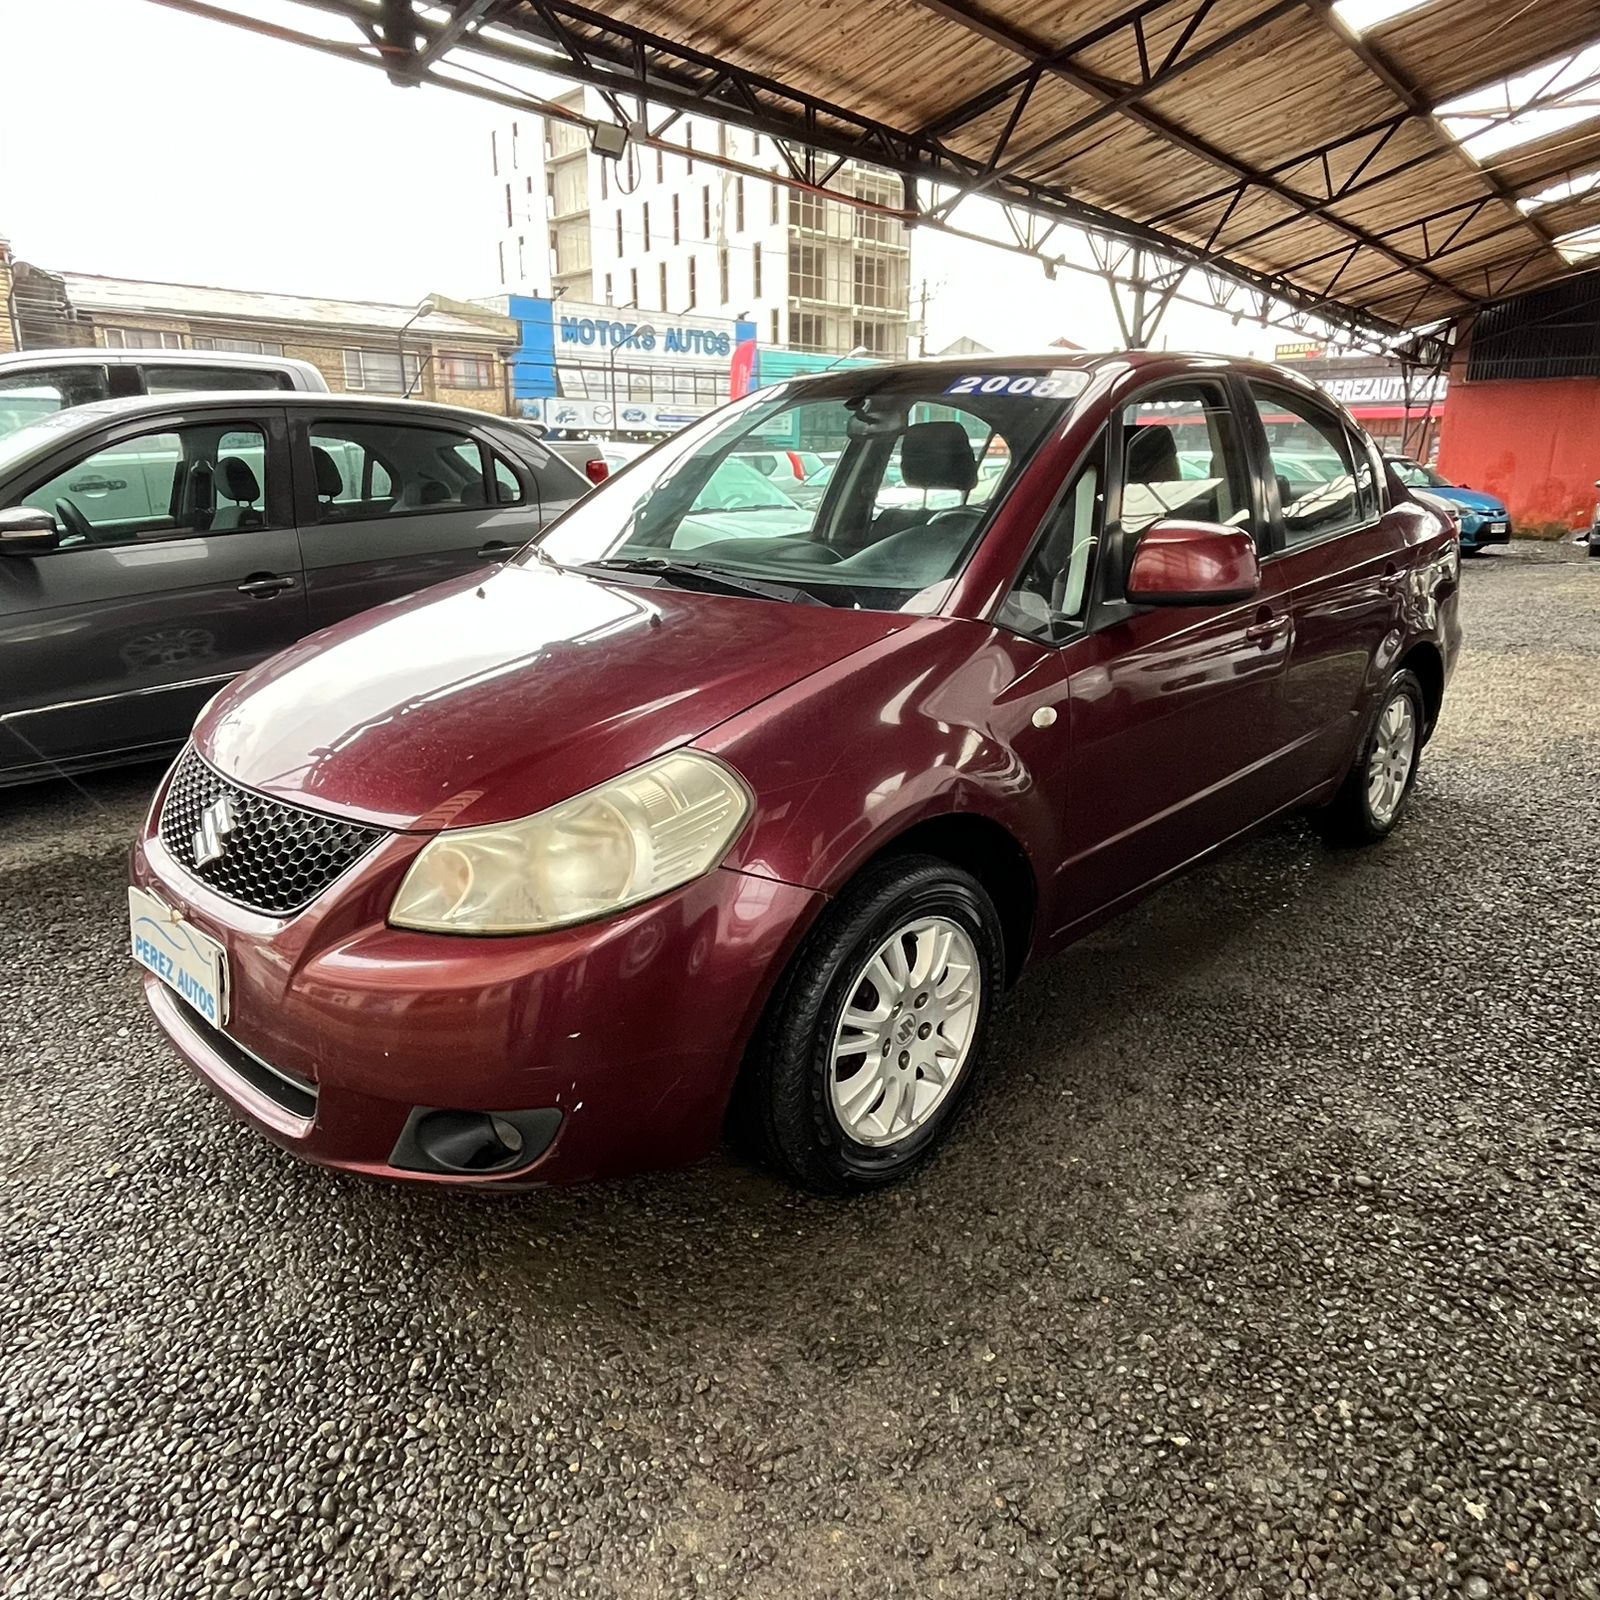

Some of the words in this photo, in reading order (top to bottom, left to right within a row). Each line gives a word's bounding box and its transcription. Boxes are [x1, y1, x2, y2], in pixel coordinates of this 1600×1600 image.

[560, 316, 656, 350] MOTORS
[664, 327, 731, 357] AUTOS
[949, 376, 1062, 398] 2008
[135, 934, 174, 982] PEREZ
[177, 967, 215, 1020] AUTOS
